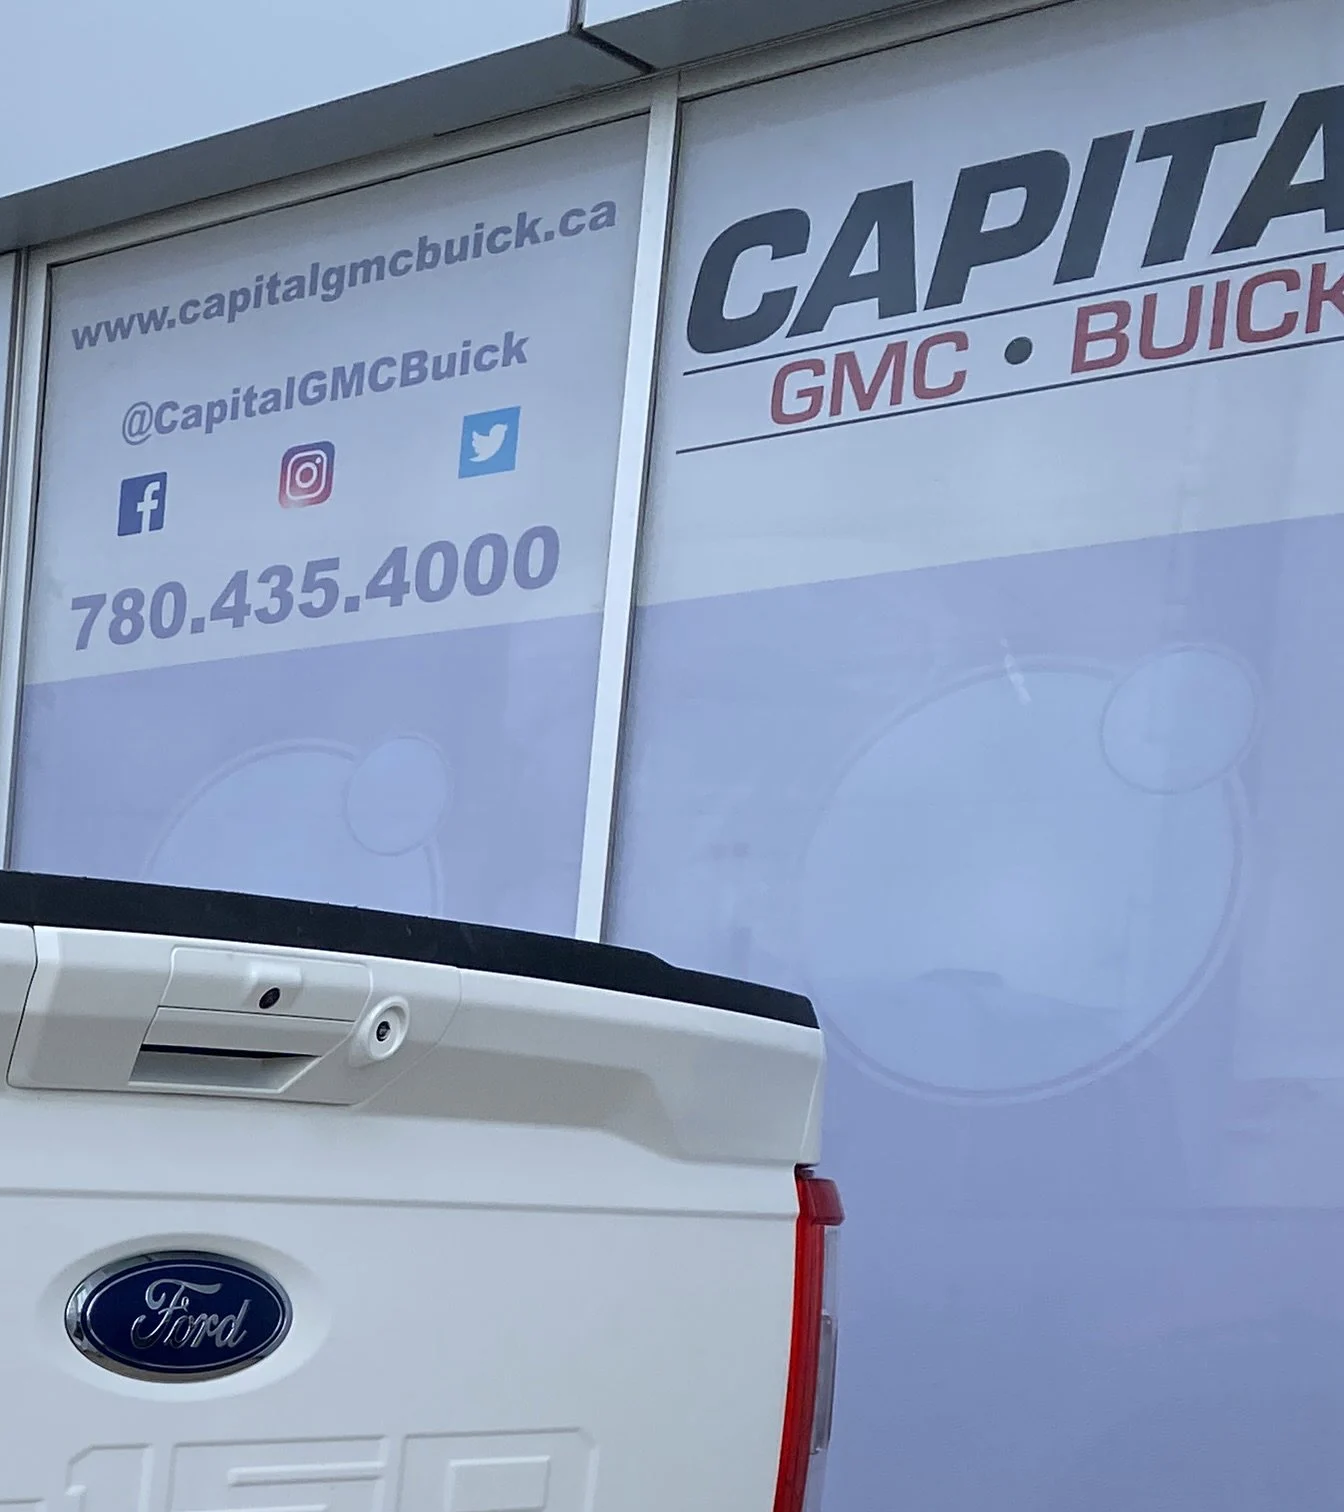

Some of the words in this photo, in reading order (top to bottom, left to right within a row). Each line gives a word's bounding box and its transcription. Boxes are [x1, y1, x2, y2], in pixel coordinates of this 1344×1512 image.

[71, 200, 616, 350] www.capitalgmcbuick.ca
[121, 331, 530, 445] @CapitalGMCBuick
[769, 330, 969, 426] GMC
[70, 525, 561, 651] 780.435.4000
[130, 1278, 252, 1349] Ford
